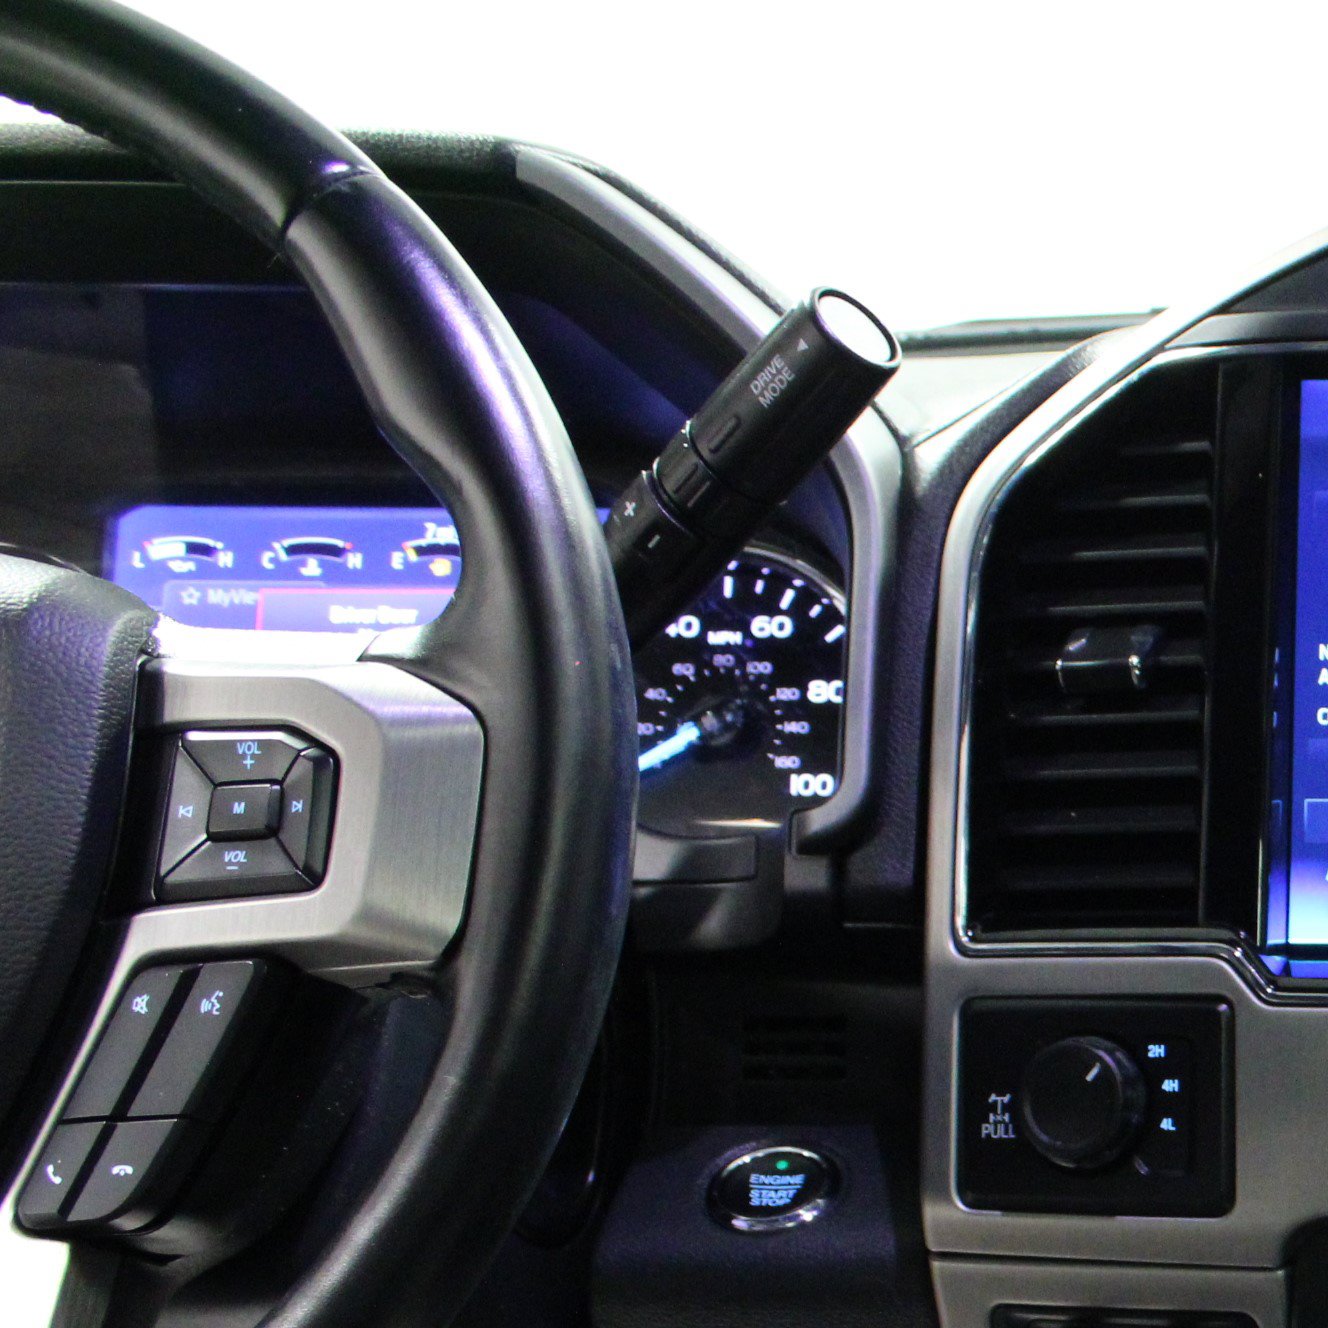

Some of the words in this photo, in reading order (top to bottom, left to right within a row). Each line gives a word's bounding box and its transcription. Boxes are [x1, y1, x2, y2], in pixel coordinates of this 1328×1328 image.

[750, 353, 786, 396] DRIVE
[758, 366, 796, 409] MODE
[132, 551, 146, 569] L
[260, 551, 275, 569] C
[347, 552, 362, 570] H
[391, 552, 404, 570] E
[750, 614, 795, 639] 60
[707, 630, 743, 646] MPH
[236, 741, 262, 755] VOL
[789, 772, 836, 798] 100
[232, 801, 246, 814] M
[222, 849, 248, 864] VOL
[1146, 1043, 1166, 1058] 2H
[1160, 1078, 1181, 1093] 4H
[981, 1122, 1016, 1139] PULL
[1159, 1117, 1177, 1131] 4L
[749, 1173, 806, 1185] ENGINE
[749, 1188, 799, 1199] START
[749, 1198, 792, 1207] STOP
